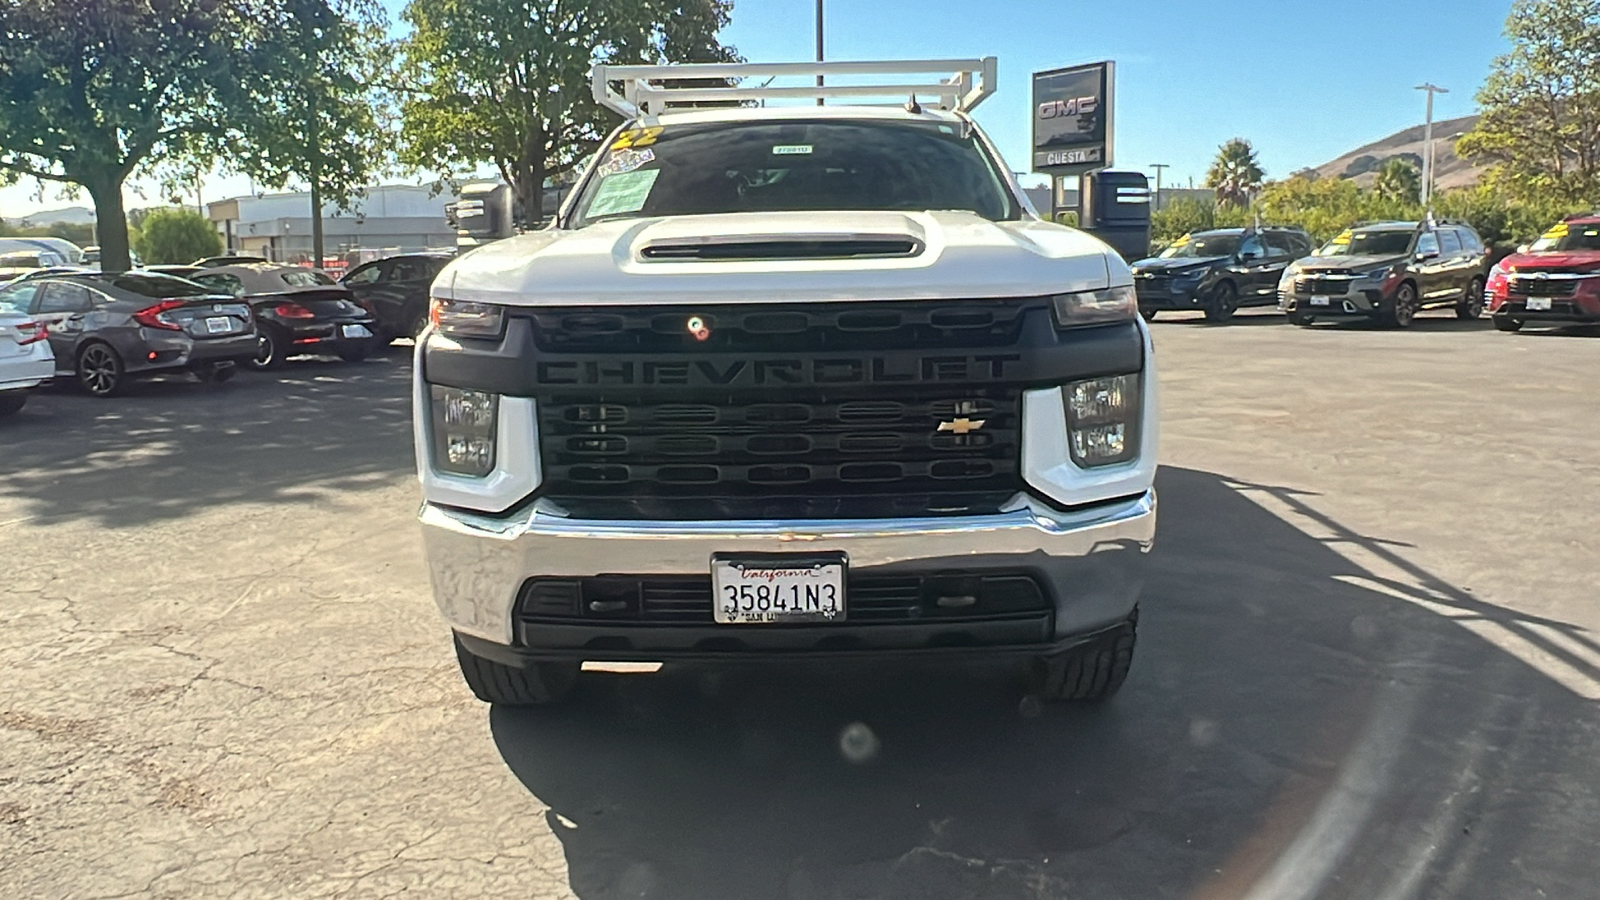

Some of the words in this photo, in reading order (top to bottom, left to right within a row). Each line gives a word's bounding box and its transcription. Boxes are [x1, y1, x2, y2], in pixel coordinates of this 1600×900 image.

[1039, 96, 1097, 119] GMC
[1047, 151, 1086, 165] CUESTA
[537, 353, 1021, 385] CHEVROLET
[741, 569, 816, 582] California
[724, 584, 836, 612] 35841N3
